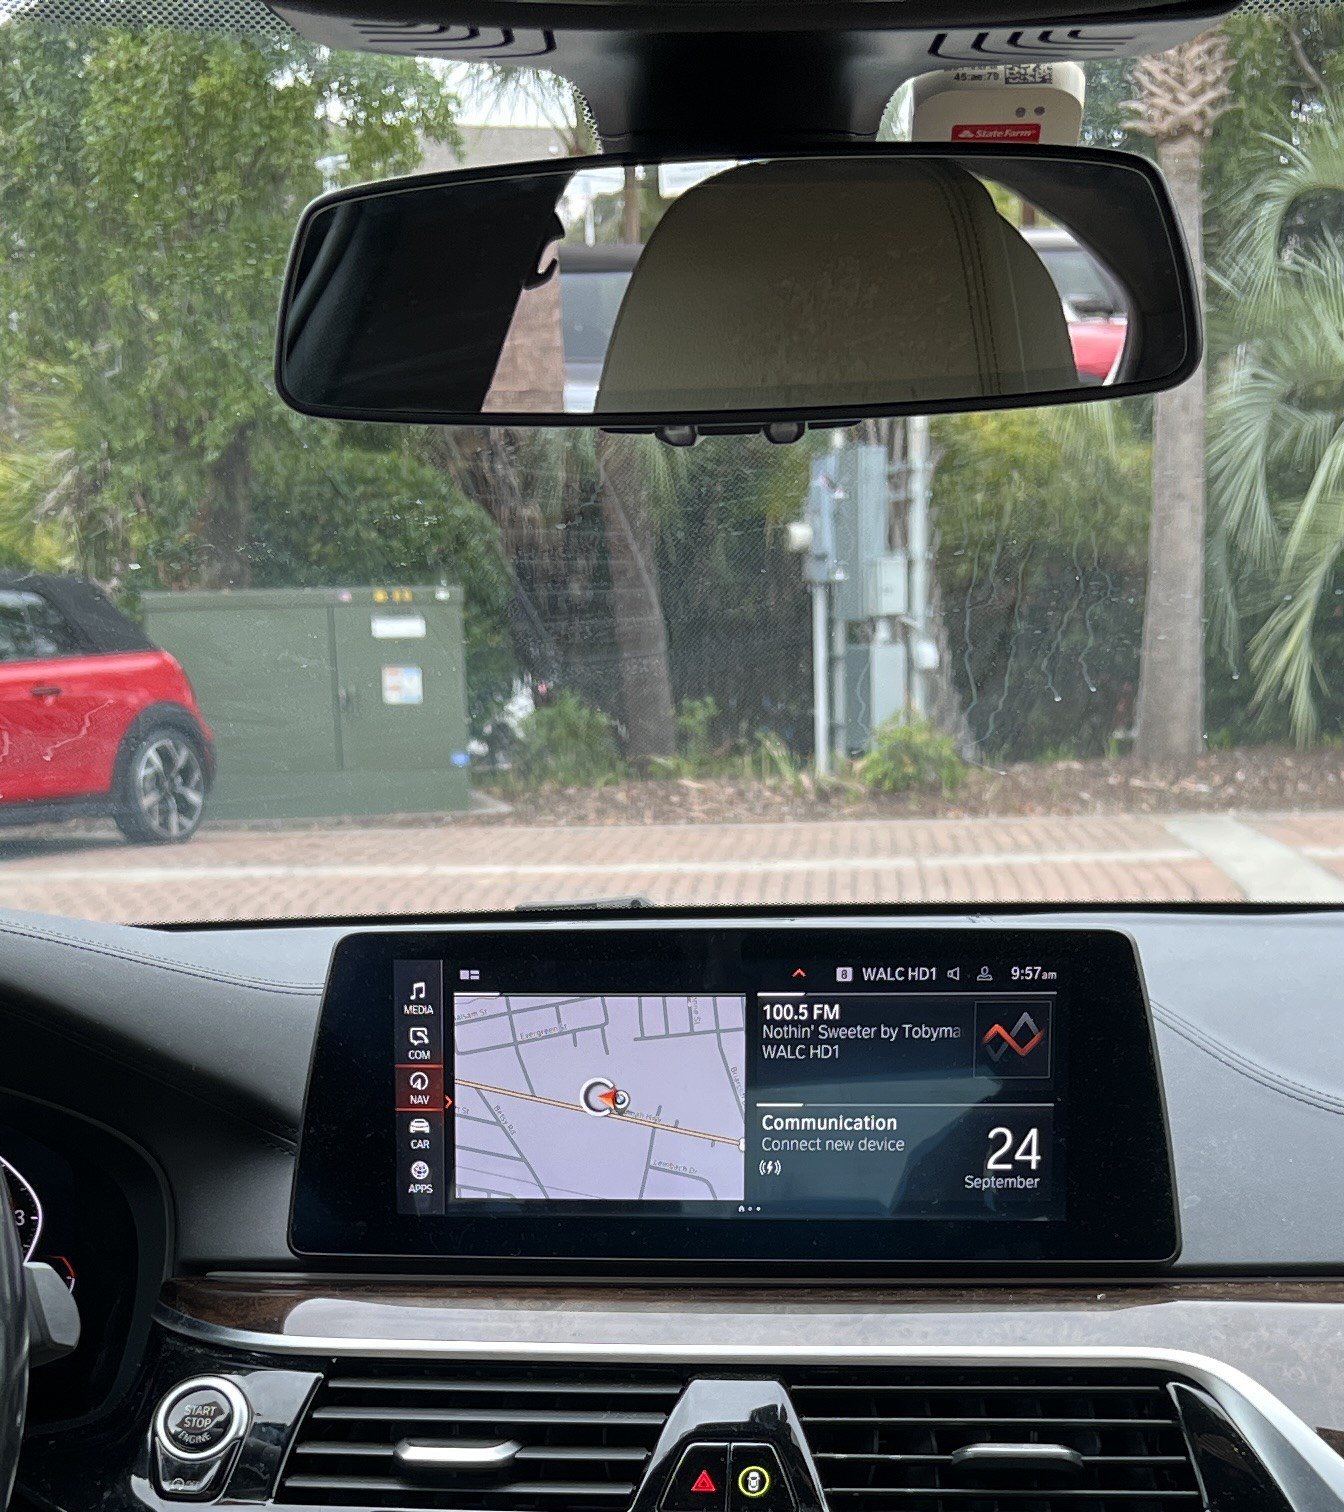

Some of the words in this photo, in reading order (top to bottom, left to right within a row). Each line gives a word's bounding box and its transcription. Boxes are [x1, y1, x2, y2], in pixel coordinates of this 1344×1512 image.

[975, 130, 1003, 138] State
[1004, 130, 1033, 138] Farm
[862, 967, 905, 981] WALC
[908, 967, 937, 981] HD1
[404, 1005, 433, 1015] MEDIA
[762, 1005, 808, 1020] 100.5
[813, 1005, 840, 1020] FM
[519, 1026, 558, 1041] Evergreen
[762, 1025, 815, 1039] Nothin'
[818, 1024, 876, 1039] Sweeter
[881, 1024, 898, 1041] by
[408, 1051, 430, 1060] COM
[762, 1045, 805, 1059] WALC
[810, 1045, 839, 1059] HD1
[410, 1095, 430, 1104] NAV
[762, 1115, 897, 1130] Communication
[410, 1139, 430, 1149] CAR
[761, 1137, 822, 1151] Connect
[825, 1140, 855, 1151] new
[857, 1137, 905, 1151] device
[986, 1127, 1041, 1170] 24
[409, 1184, 433, 1194] APPS
[964, 1176, 1040, 1189] September
[14, 1209, 25, 1226] 3
[184, 1405, 217, 1416] START
[184, 1417, 211, 1428] STOP
[178, 1430, 212, 1443] ENGINE
